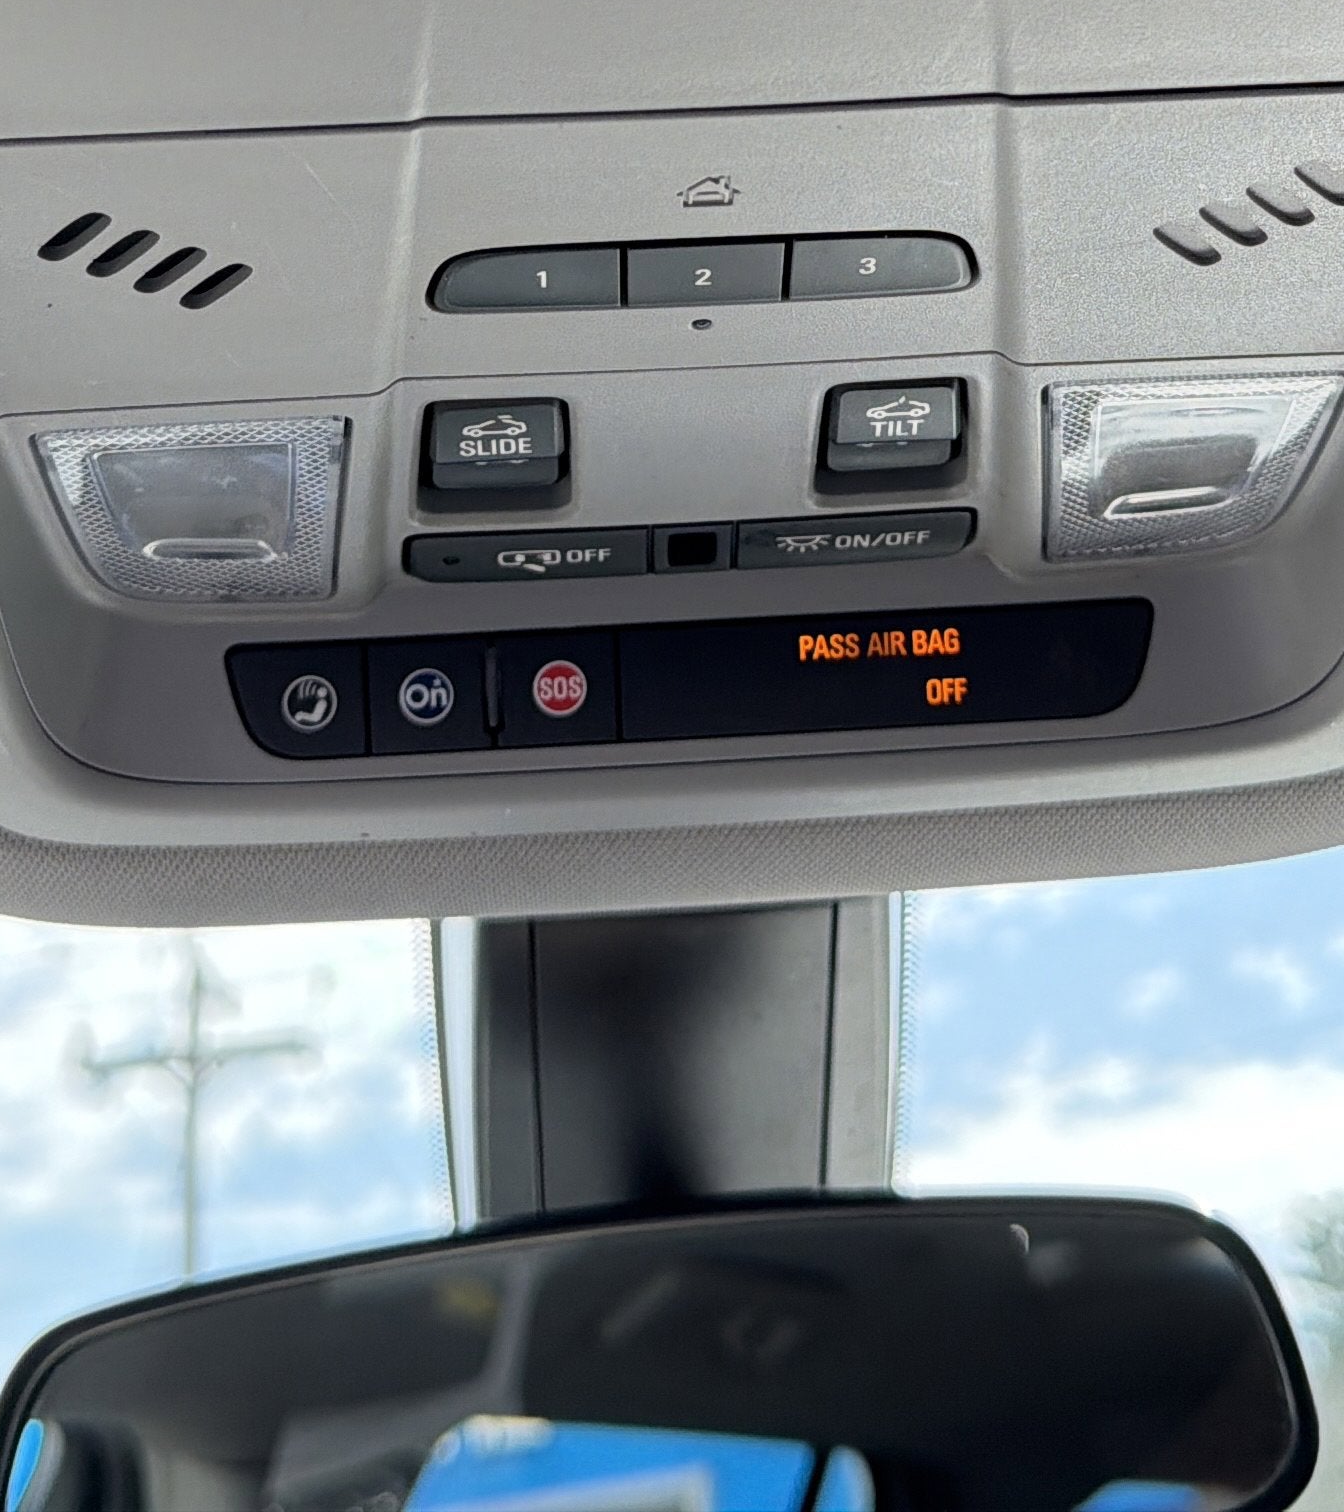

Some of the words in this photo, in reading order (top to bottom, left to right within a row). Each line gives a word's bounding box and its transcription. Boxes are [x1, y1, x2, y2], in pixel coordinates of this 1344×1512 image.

[858, 257, 877, 275] 3
[536, 270, 549, 288] 1
[694, 268, 712, 286] 2
[870, 419, 925, 438] TILT
[459, 436, 533, 457] SLIDE
[834, 529, 930, 550] ON/OFF
[565, 547, 612, 564] OFF
[798, 632, 860, 662] PASS
[867, 630, 907, 657] AIR
[911, 627, 961, 656] BAG
[538, 675, 582, 701] SOS
[925, 677, 968, 706] OFF
